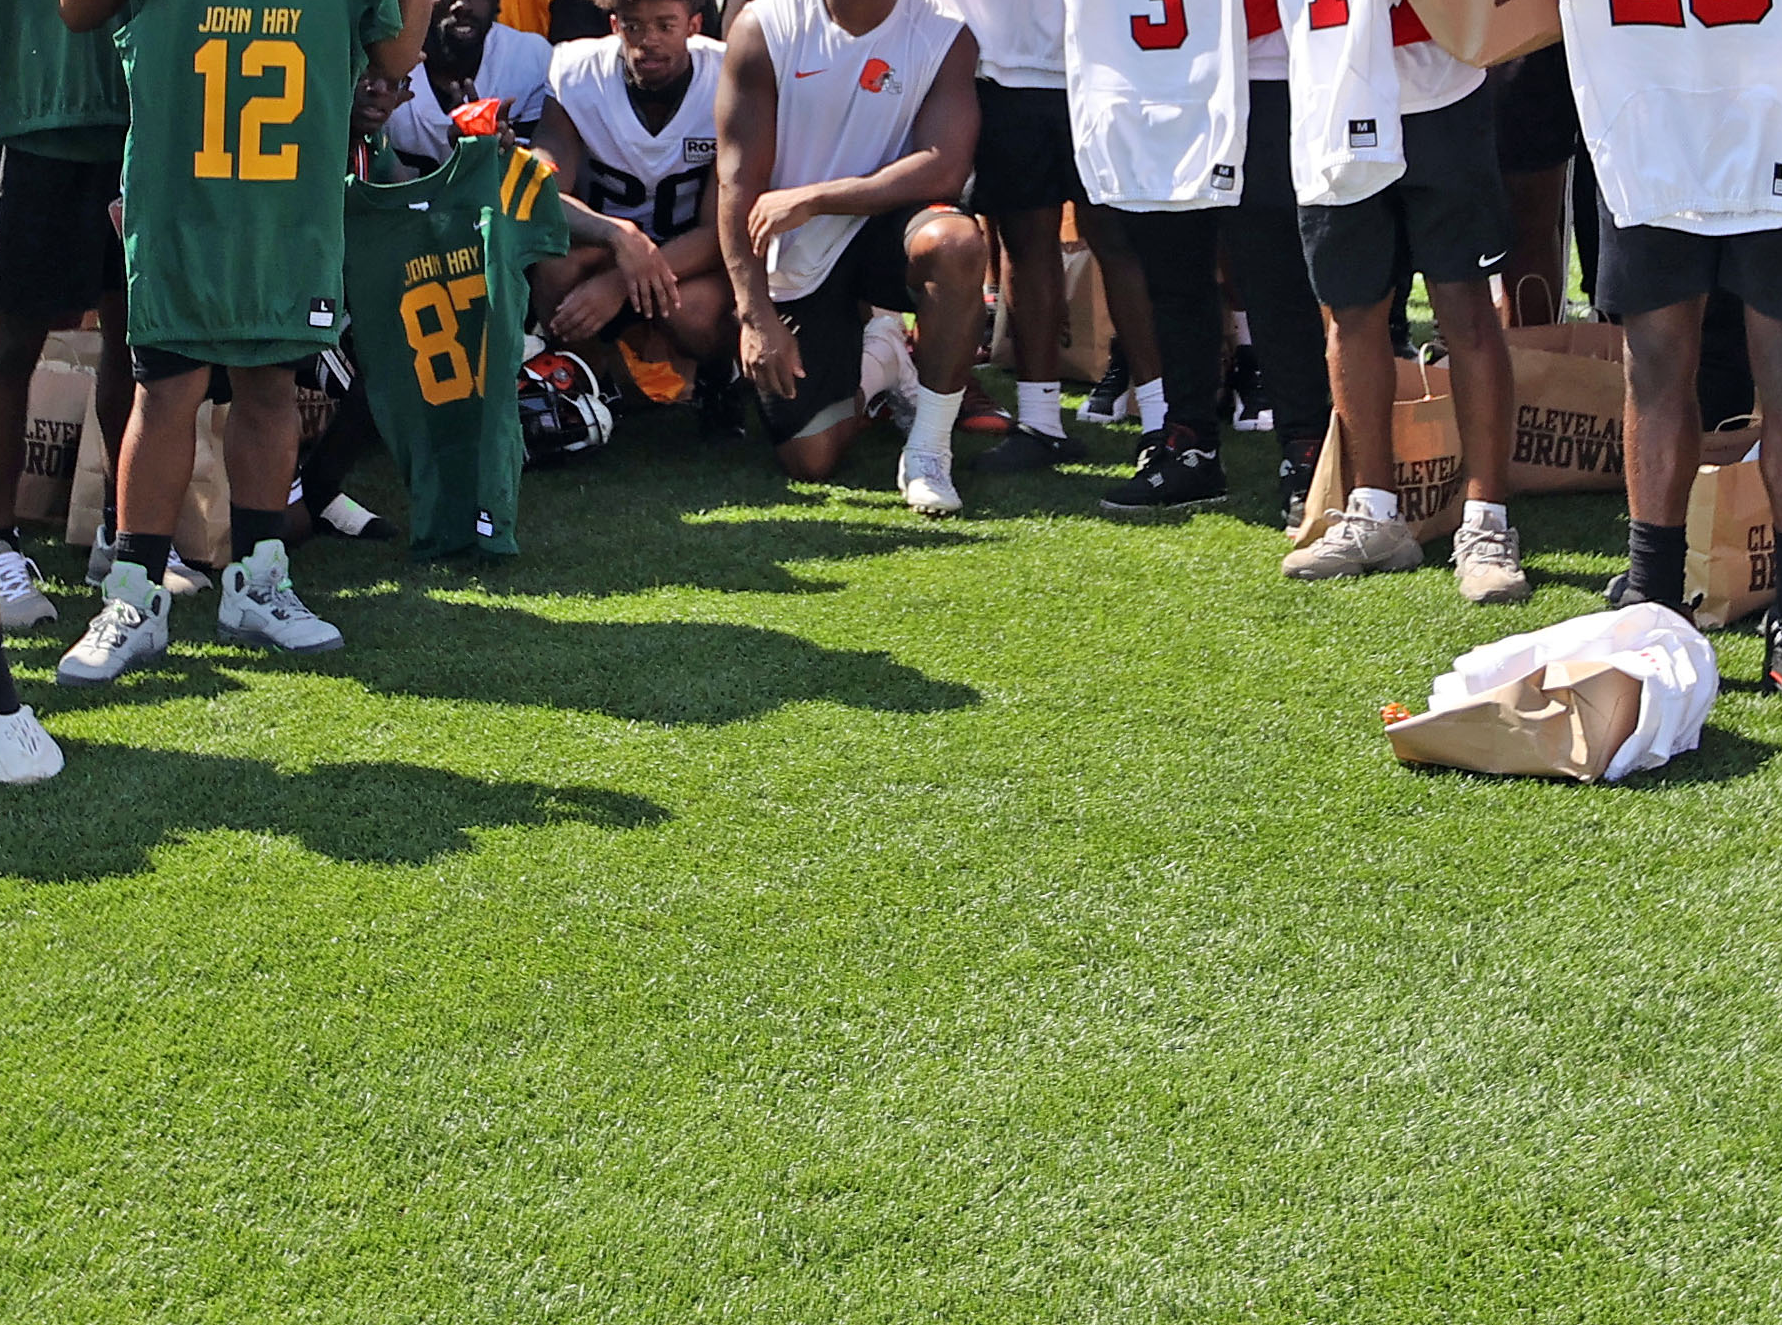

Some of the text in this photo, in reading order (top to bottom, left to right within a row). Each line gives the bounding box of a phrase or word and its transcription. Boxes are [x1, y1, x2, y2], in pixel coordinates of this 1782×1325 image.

[199, 6, 302, 35] JOHN HAY
[195, 39, 305, 180] 12
[1356, 122, 1368, 133] M
[405, 246, 481, 287] JOHN HAY
[400, 274, 489, 406] 87
[1393, 456, 1456, 487] LEVEL
[1397, 479, 1460, 522] ROW
